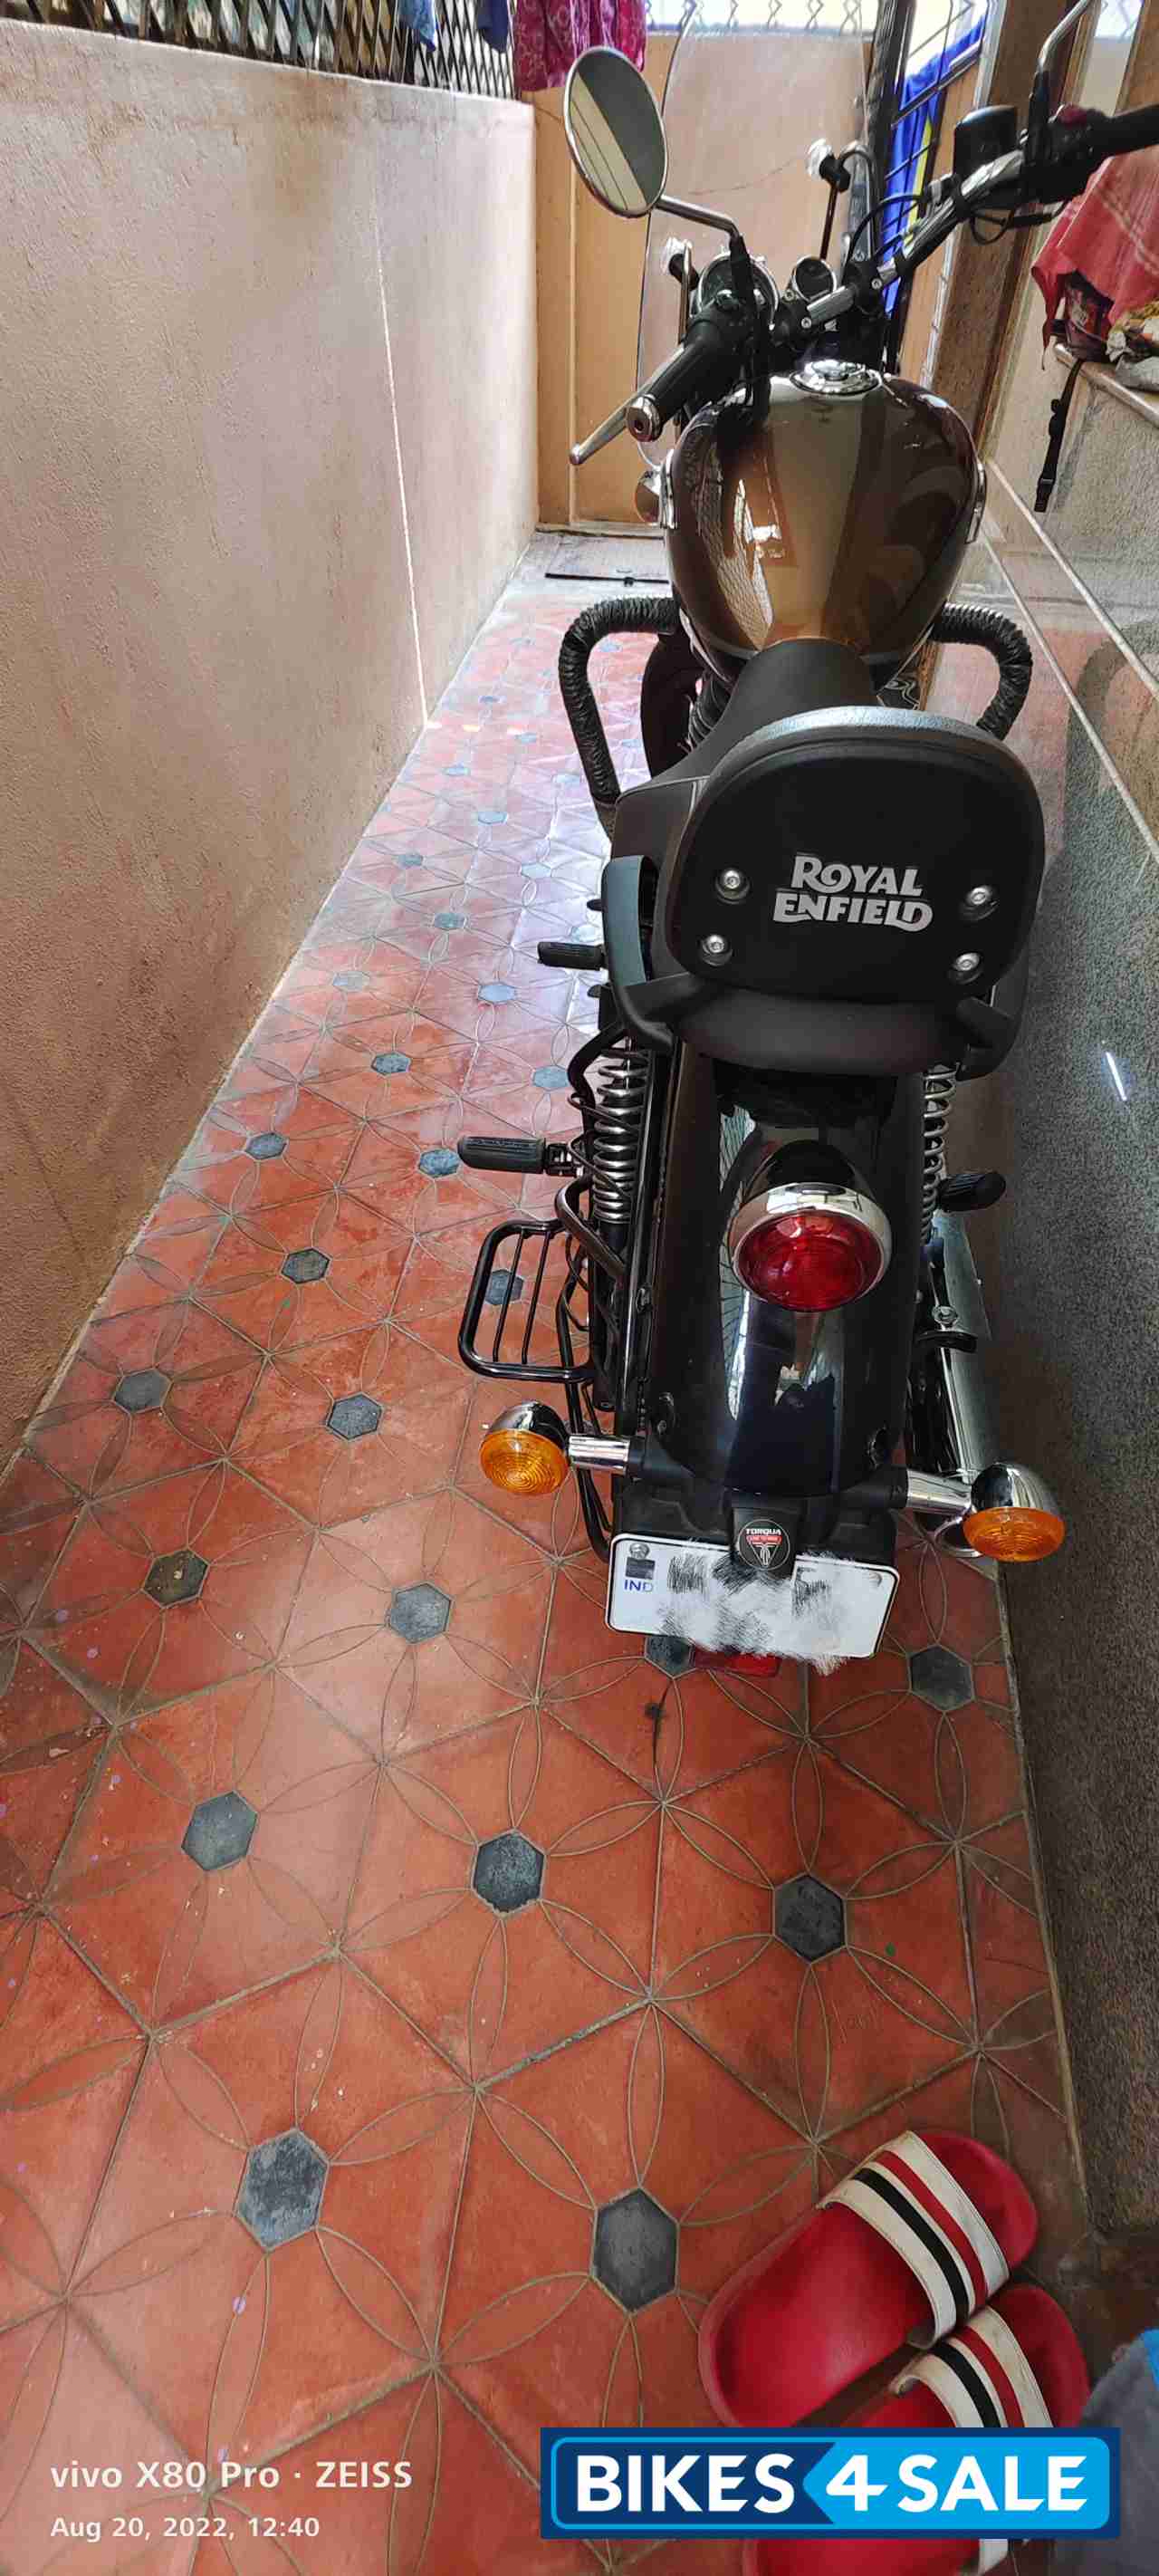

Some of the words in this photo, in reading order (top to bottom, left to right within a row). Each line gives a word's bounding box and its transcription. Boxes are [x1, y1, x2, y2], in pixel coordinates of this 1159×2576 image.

[790, 855, 923, 896] ROYAL
[772, 891, 934, 932] ENFIELD
[745, 1528, 782, 1536] TORQUA
[624, 1579, 653, 1592] IND
